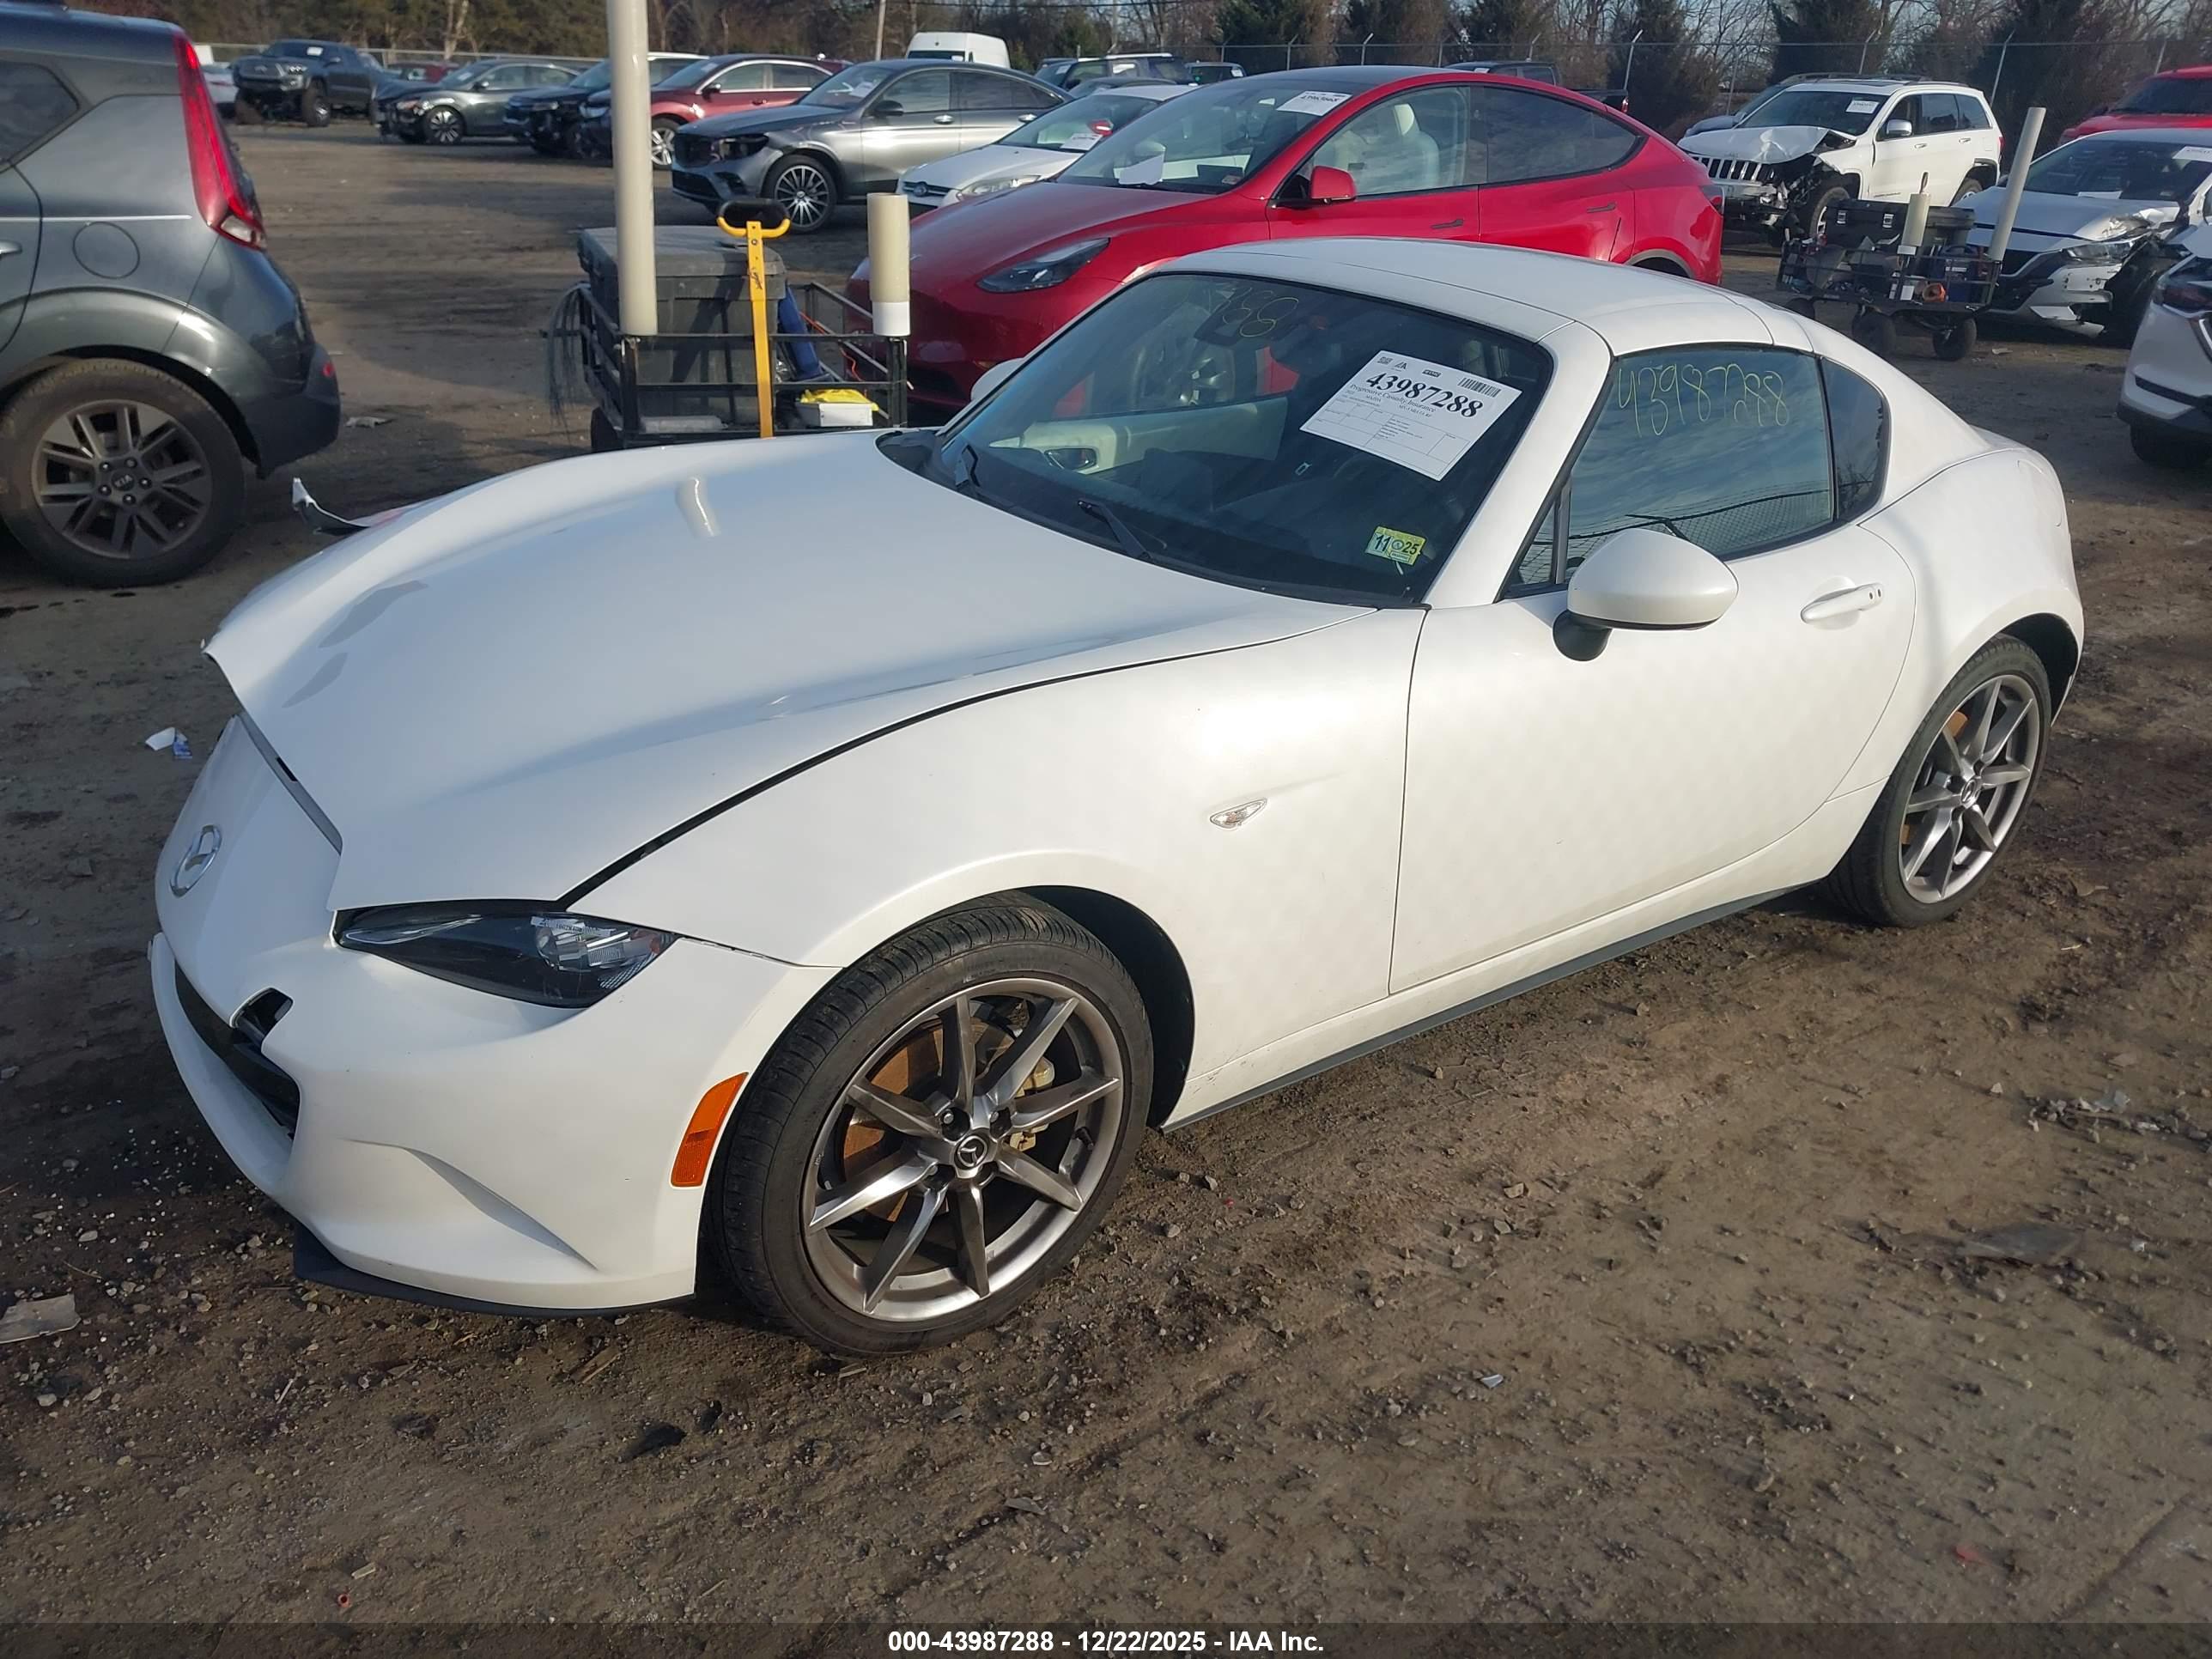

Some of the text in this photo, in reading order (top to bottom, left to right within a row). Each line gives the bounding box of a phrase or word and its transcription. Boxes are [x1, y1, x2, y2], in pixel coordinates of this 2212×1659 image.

[1366, 372, 1484, 418] 43987288
[1407, 398, 1437, 412] Insurance
[1618, 363, 1790, 437] 43987288
[1376, 534, 1420, 556] 11 25
